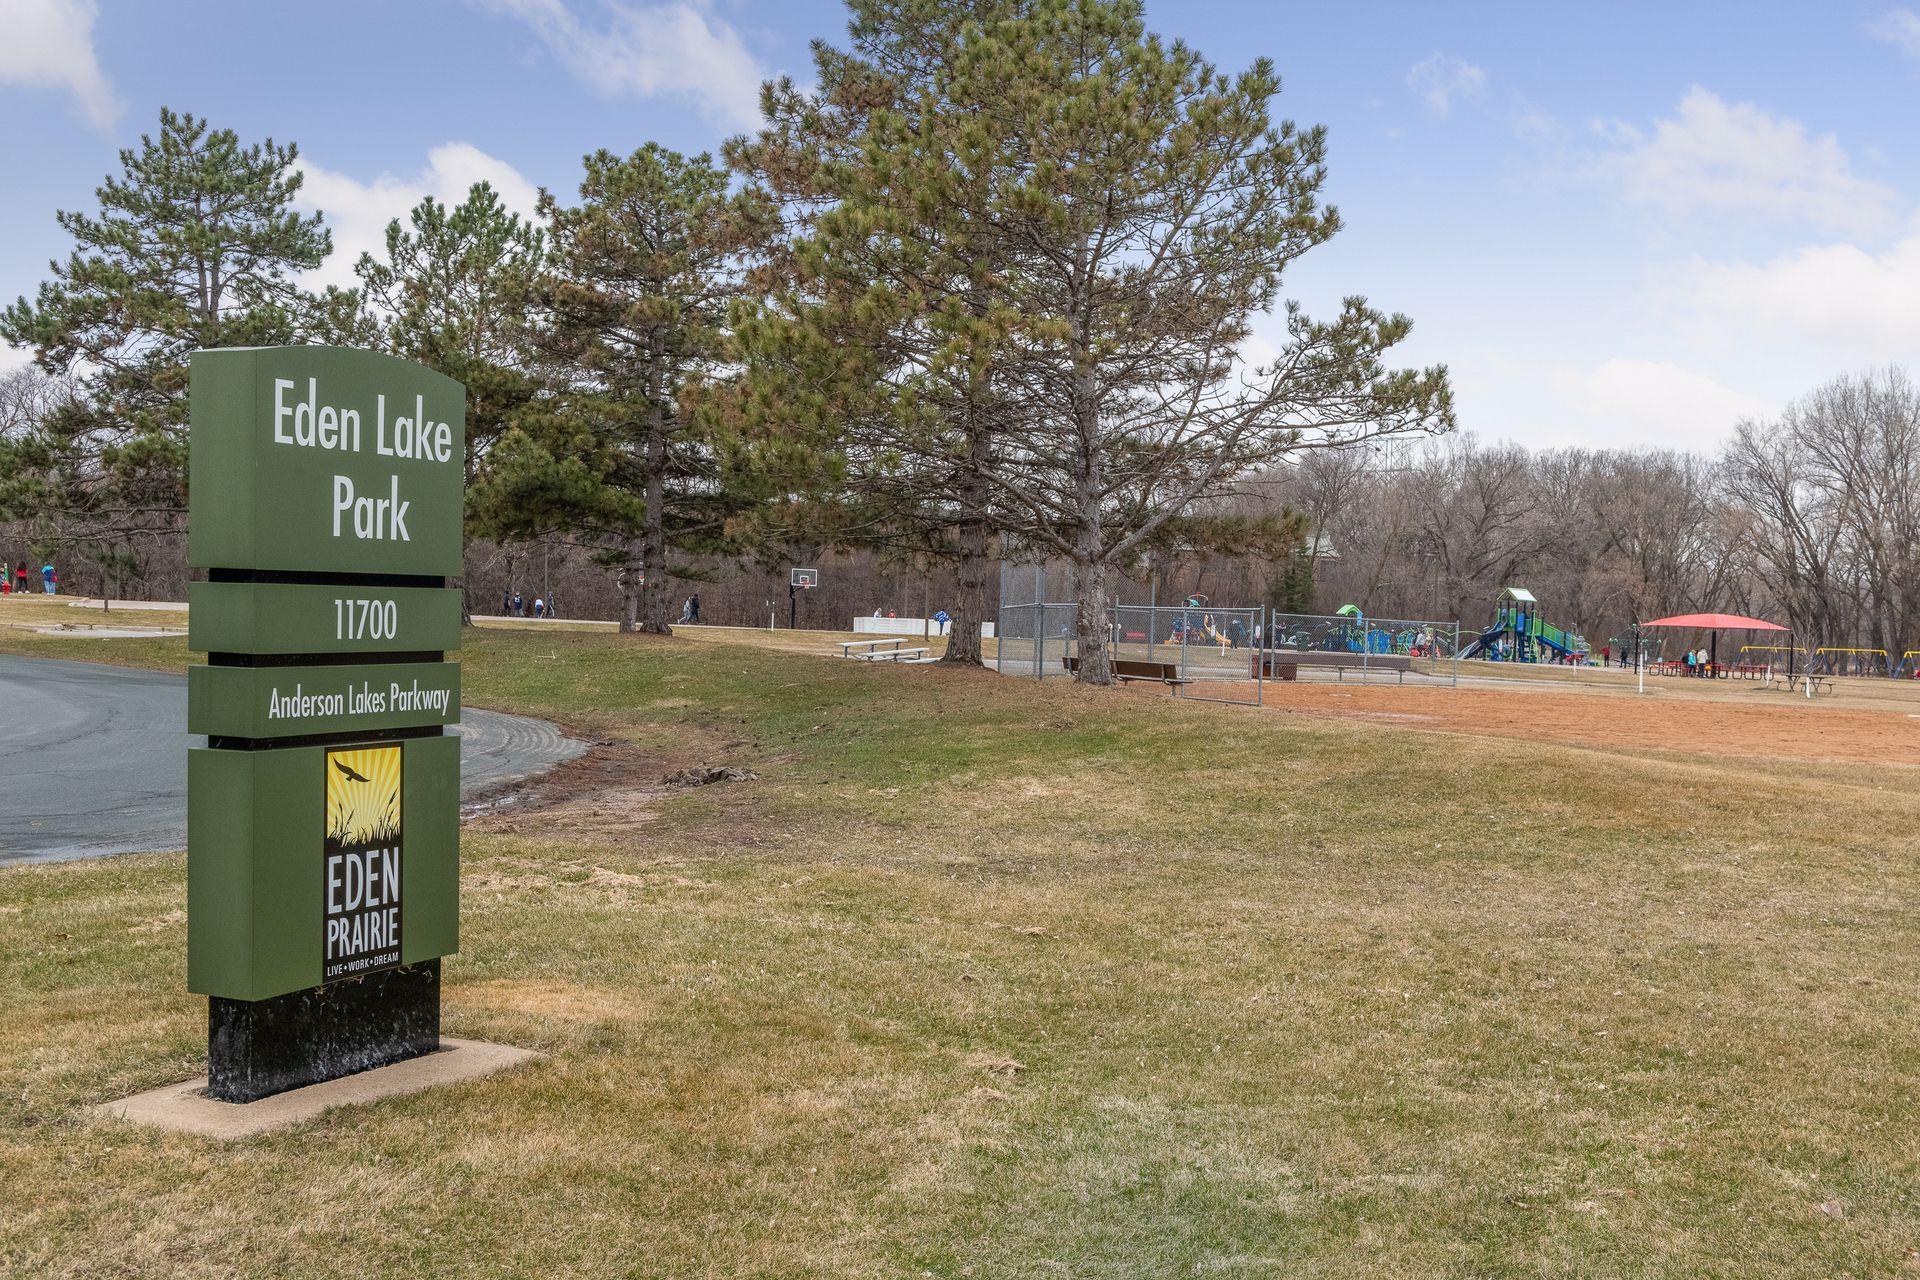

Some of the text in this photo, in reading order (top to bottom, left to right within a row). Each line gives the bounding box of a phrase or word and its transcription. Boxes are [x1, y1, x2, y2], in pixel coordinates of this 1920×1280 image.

[274, 377, 452, 463] Eden Lake
[333, 475, 411, 542] Park
[334, 599, 397, 640] 11700
[268, 679, 451, 719] Anderson Lakes Parkway
[328, 847, 399, 915] EDEN
[327, 908, 399, 960] PRAIRIE
